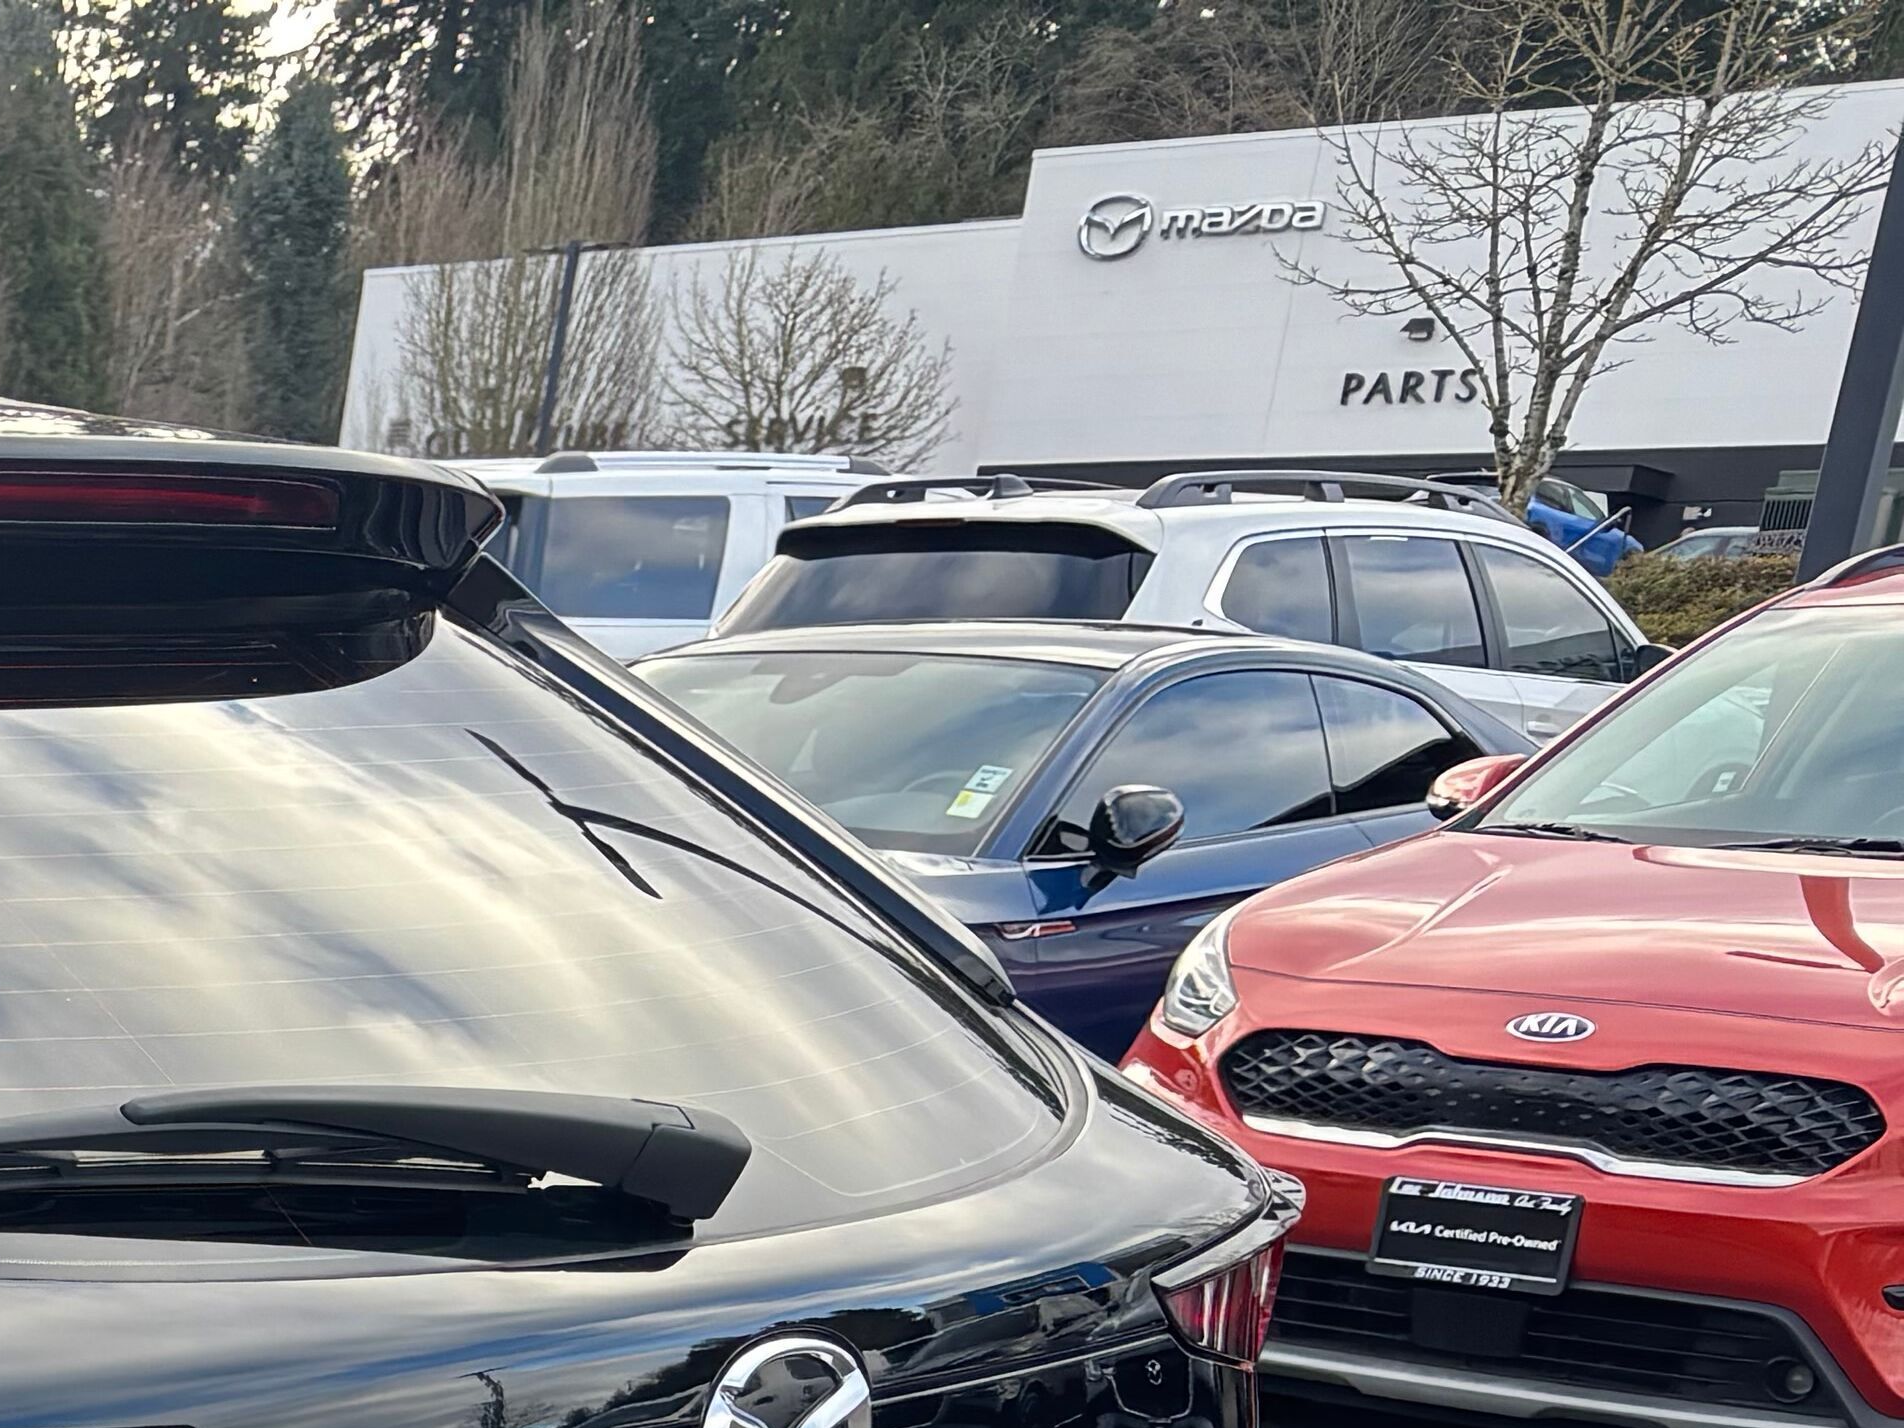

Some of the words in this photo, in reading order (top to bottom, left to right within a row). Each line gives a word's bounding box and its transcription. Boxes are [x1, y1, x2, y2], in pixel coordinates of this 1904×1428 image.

[1158, 200, 1327, 241] mazda
[1340, 368, 1479, 407] PARTS
[1433, 1225, 1488, 1243] Certified
[1487, 1231, 1559, 1251] Pre-Owned
[1414, 1266, 1466, 1284] SINCE
[1469, 1273, 1511, 1289] 1933
